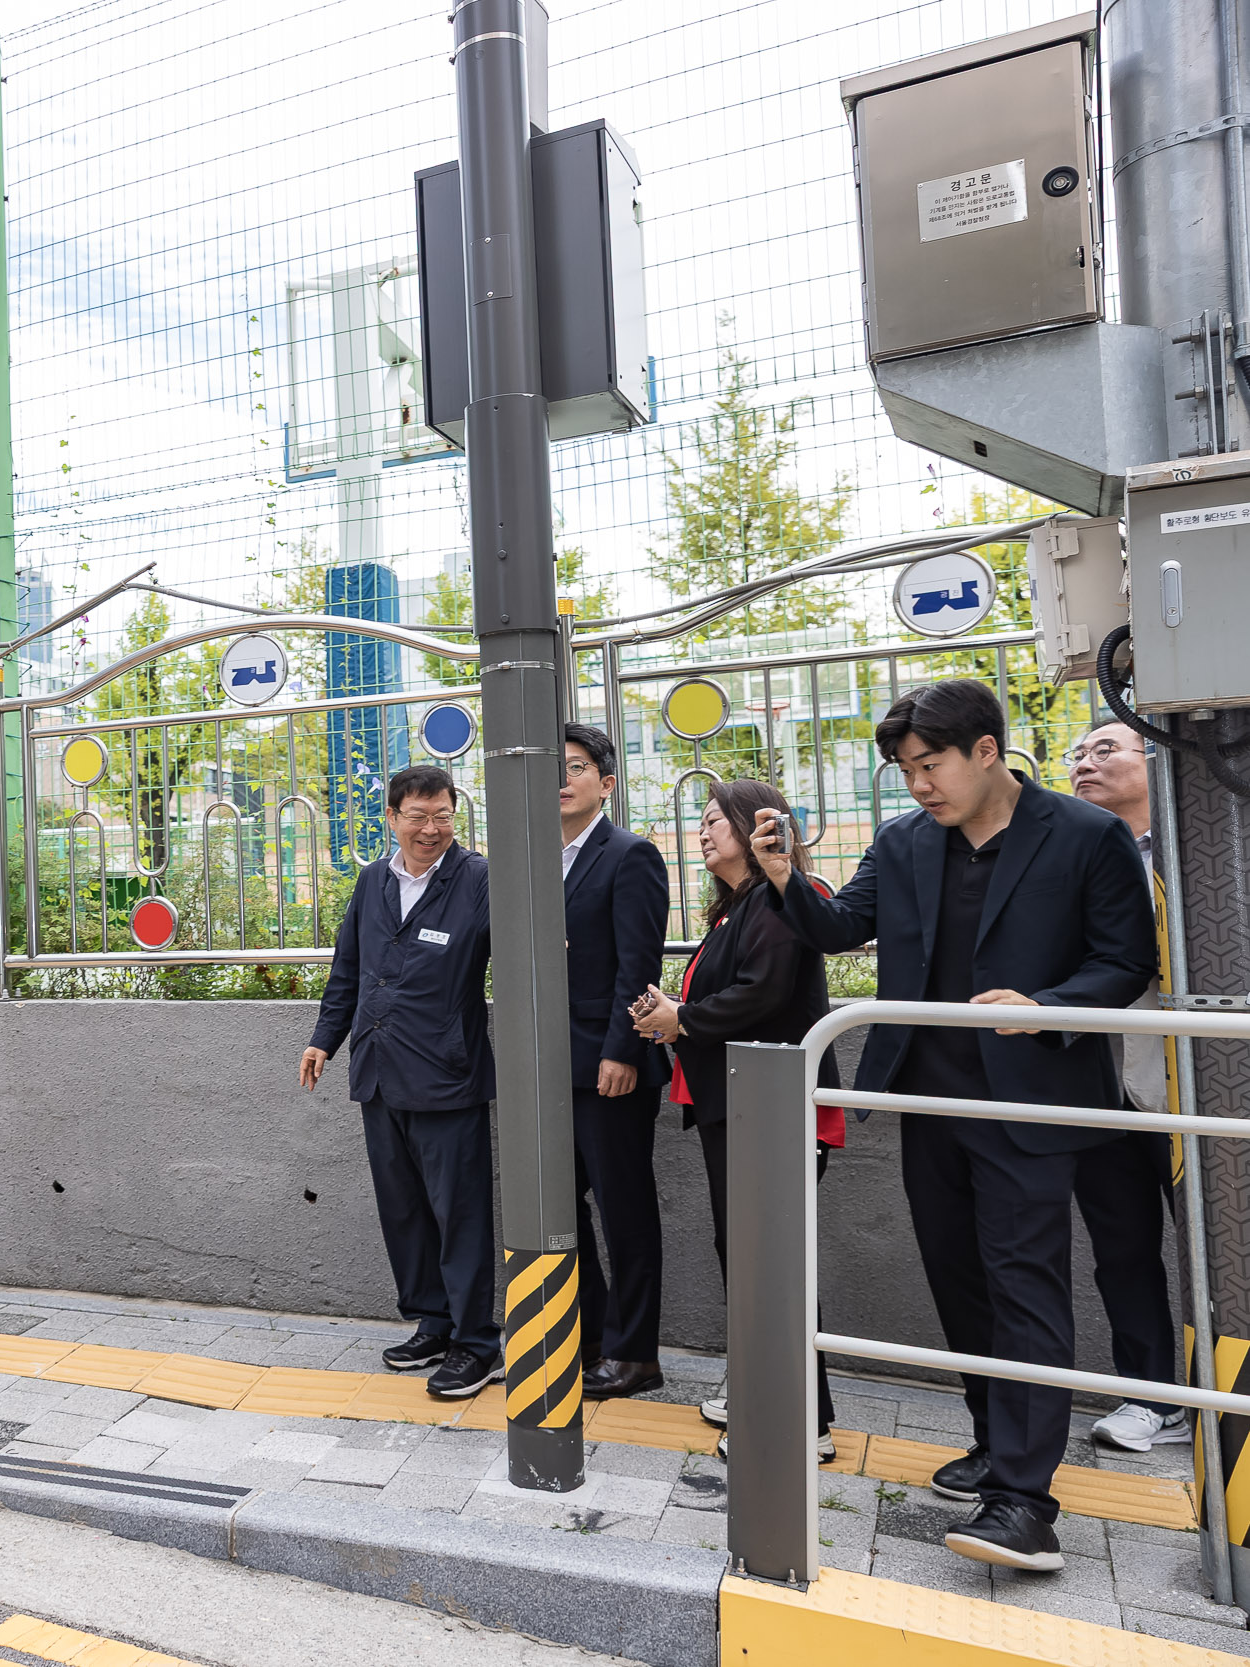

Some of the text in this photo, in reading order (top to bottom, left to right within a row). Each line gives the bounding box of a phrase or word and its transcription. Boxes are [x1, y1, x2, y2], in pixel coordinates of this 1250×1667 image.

[951, 173, 992, 191] 경고문
[972, 187, 990, 197] 함부로
[930, 190, 1015, 215] 기계를 만지는 사람은 도로교통법
[1166, 515, 1200, 527] 활주로형
[1204, 510, 1237, 523] 횡단보도
